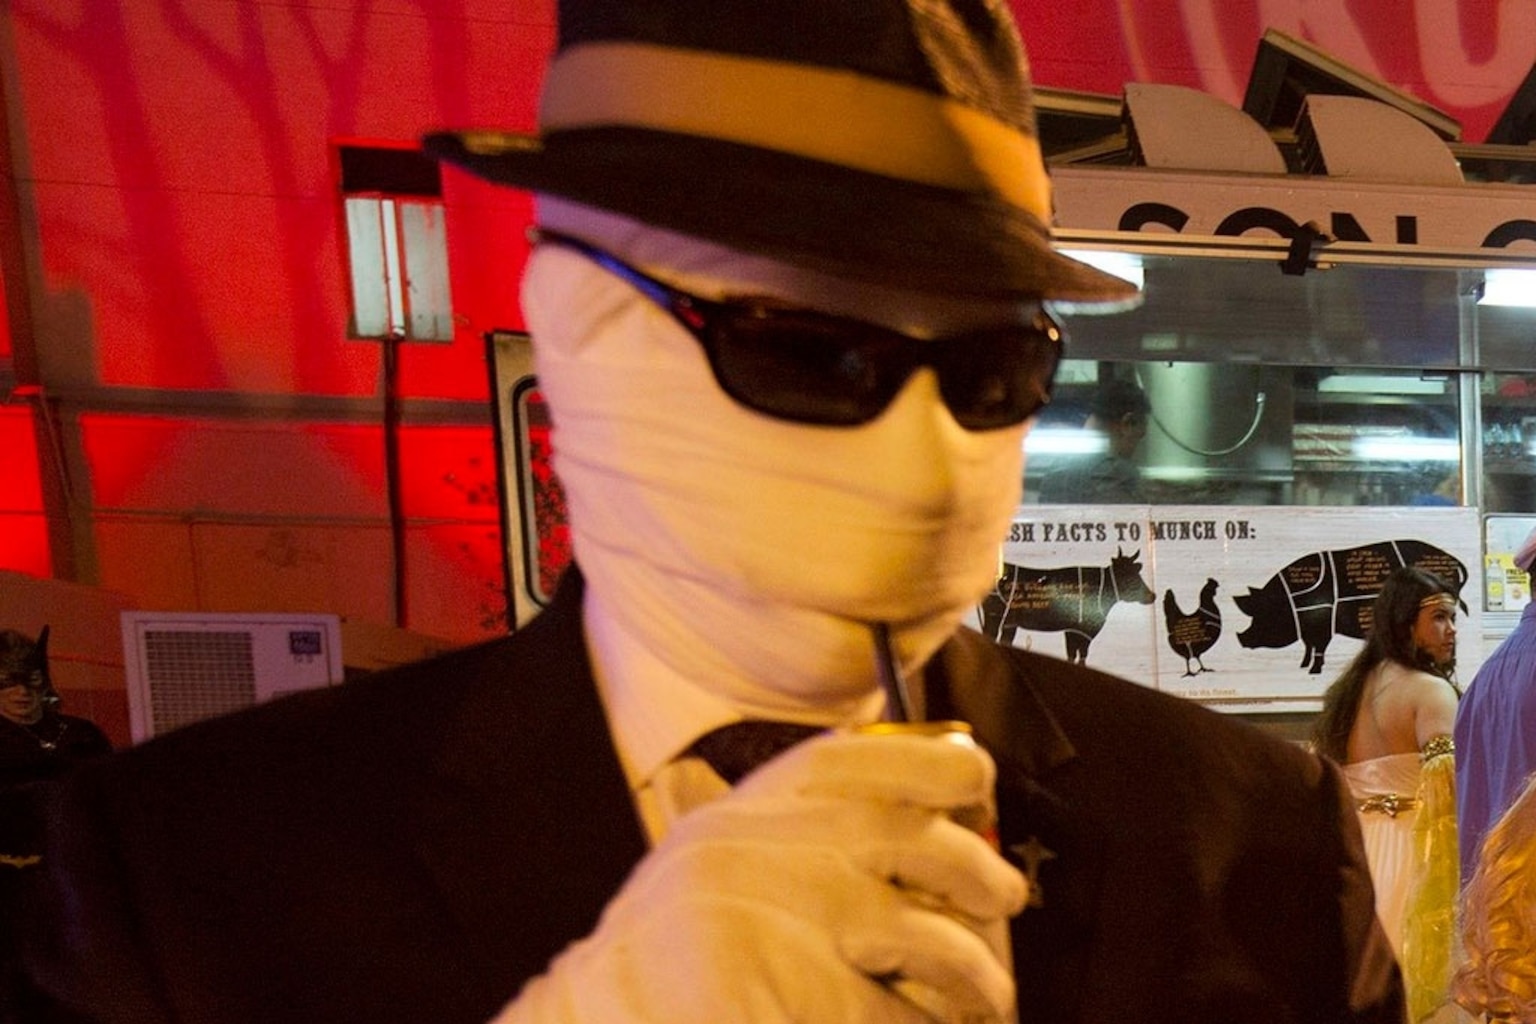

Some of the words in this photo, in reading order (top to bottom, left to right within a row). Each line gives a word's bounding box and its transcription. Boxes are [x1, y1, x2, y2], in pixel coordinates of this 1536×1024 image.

[1043, 522, 1107, 543] FACTS
[1114, 522, 1141, 542] TO
[1152, 521, 1217, 541] MUNCH
[1225, 520, 1257, 540] ON:
